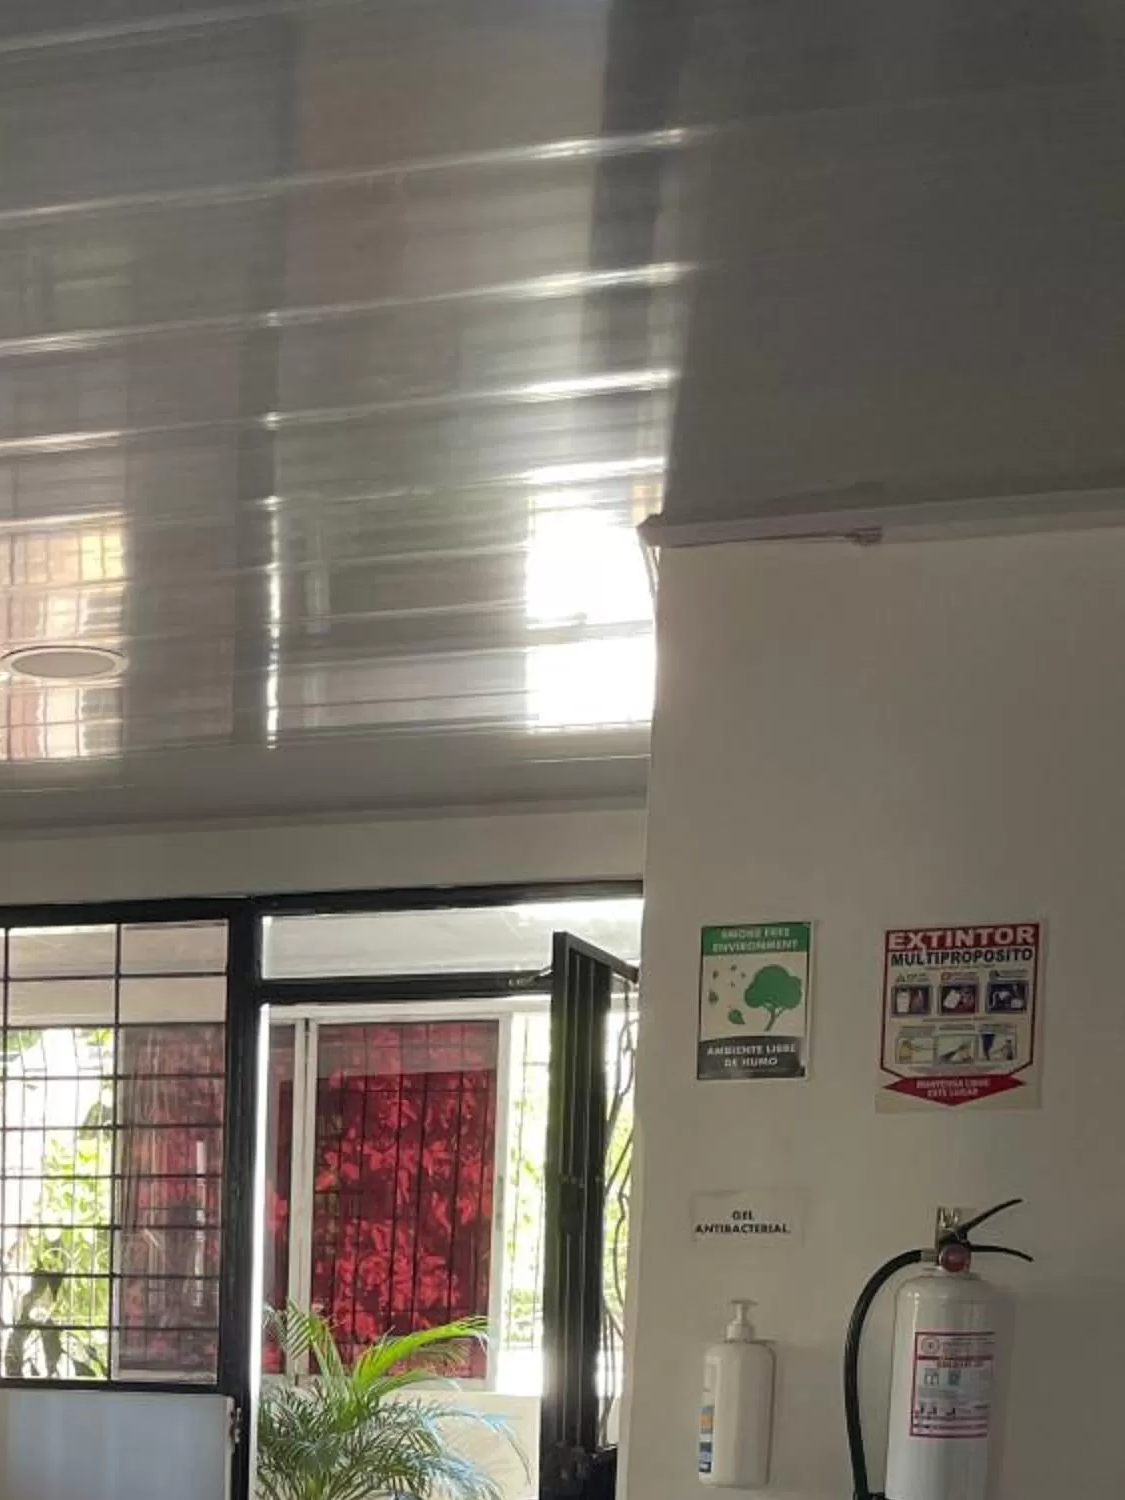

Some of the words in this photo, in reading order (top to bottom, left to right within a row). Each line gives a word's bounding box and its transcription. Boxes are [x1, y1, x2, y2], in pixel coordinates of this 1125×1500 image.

[888, 926, 1035, 949] EXTINTOR
[890, 948, 1033, 967] MULTIPROPOSITO
[707, 1044, 763, 1056] AMBIENTE
[724, 1057, 737, 1068] DE
[742, 1056, 778, 1067] HUMO
[732, 1209, 755, 1221] GEL
[695, 1223, 791, 1234] ANTIBACTERIAL
